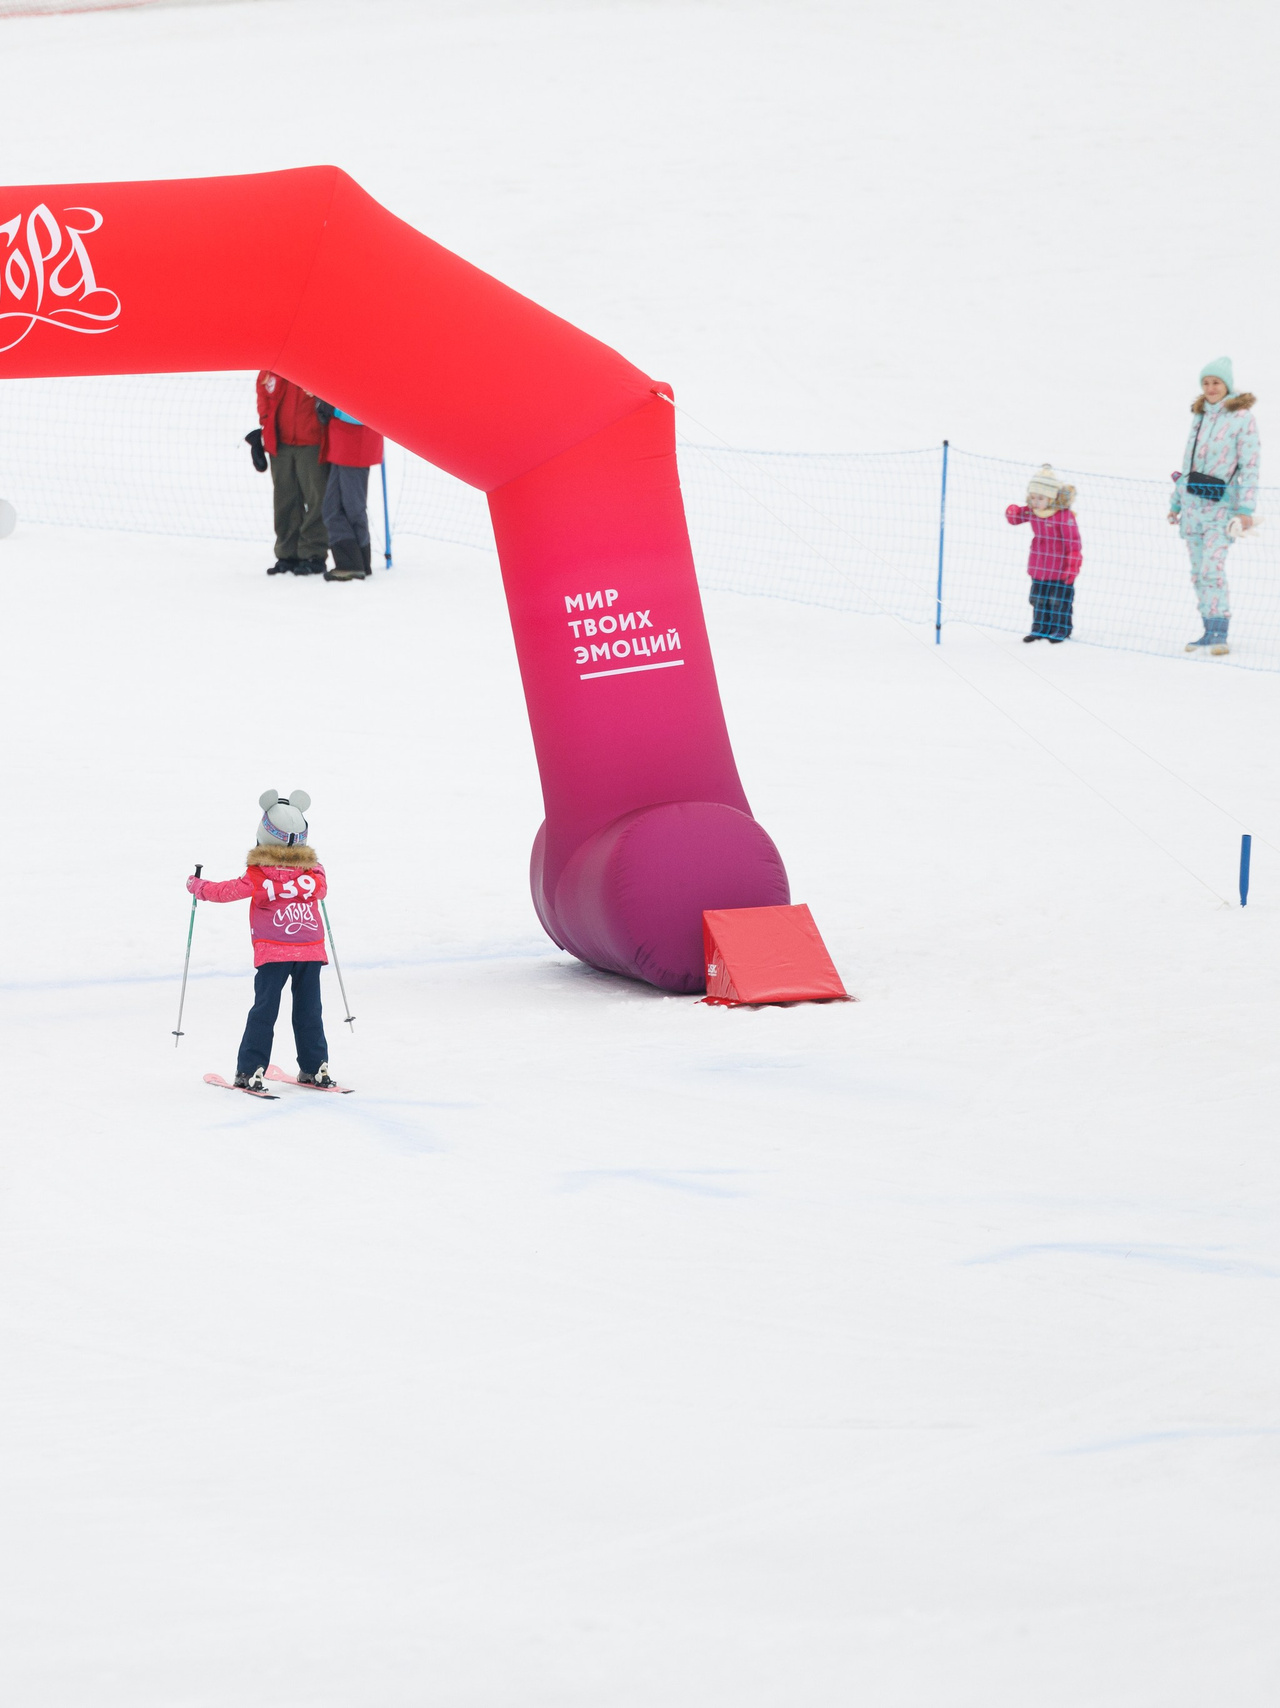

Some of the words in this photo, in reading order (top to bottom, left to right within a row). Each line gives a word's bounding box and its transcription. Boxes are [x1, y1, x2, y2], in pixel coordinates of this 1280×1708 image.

[564, 588, 619, 614] МИР
[567, 609, 654, 639] ТВОИХ
[573, 628, 682, 665] ЭМОЦИЙ
